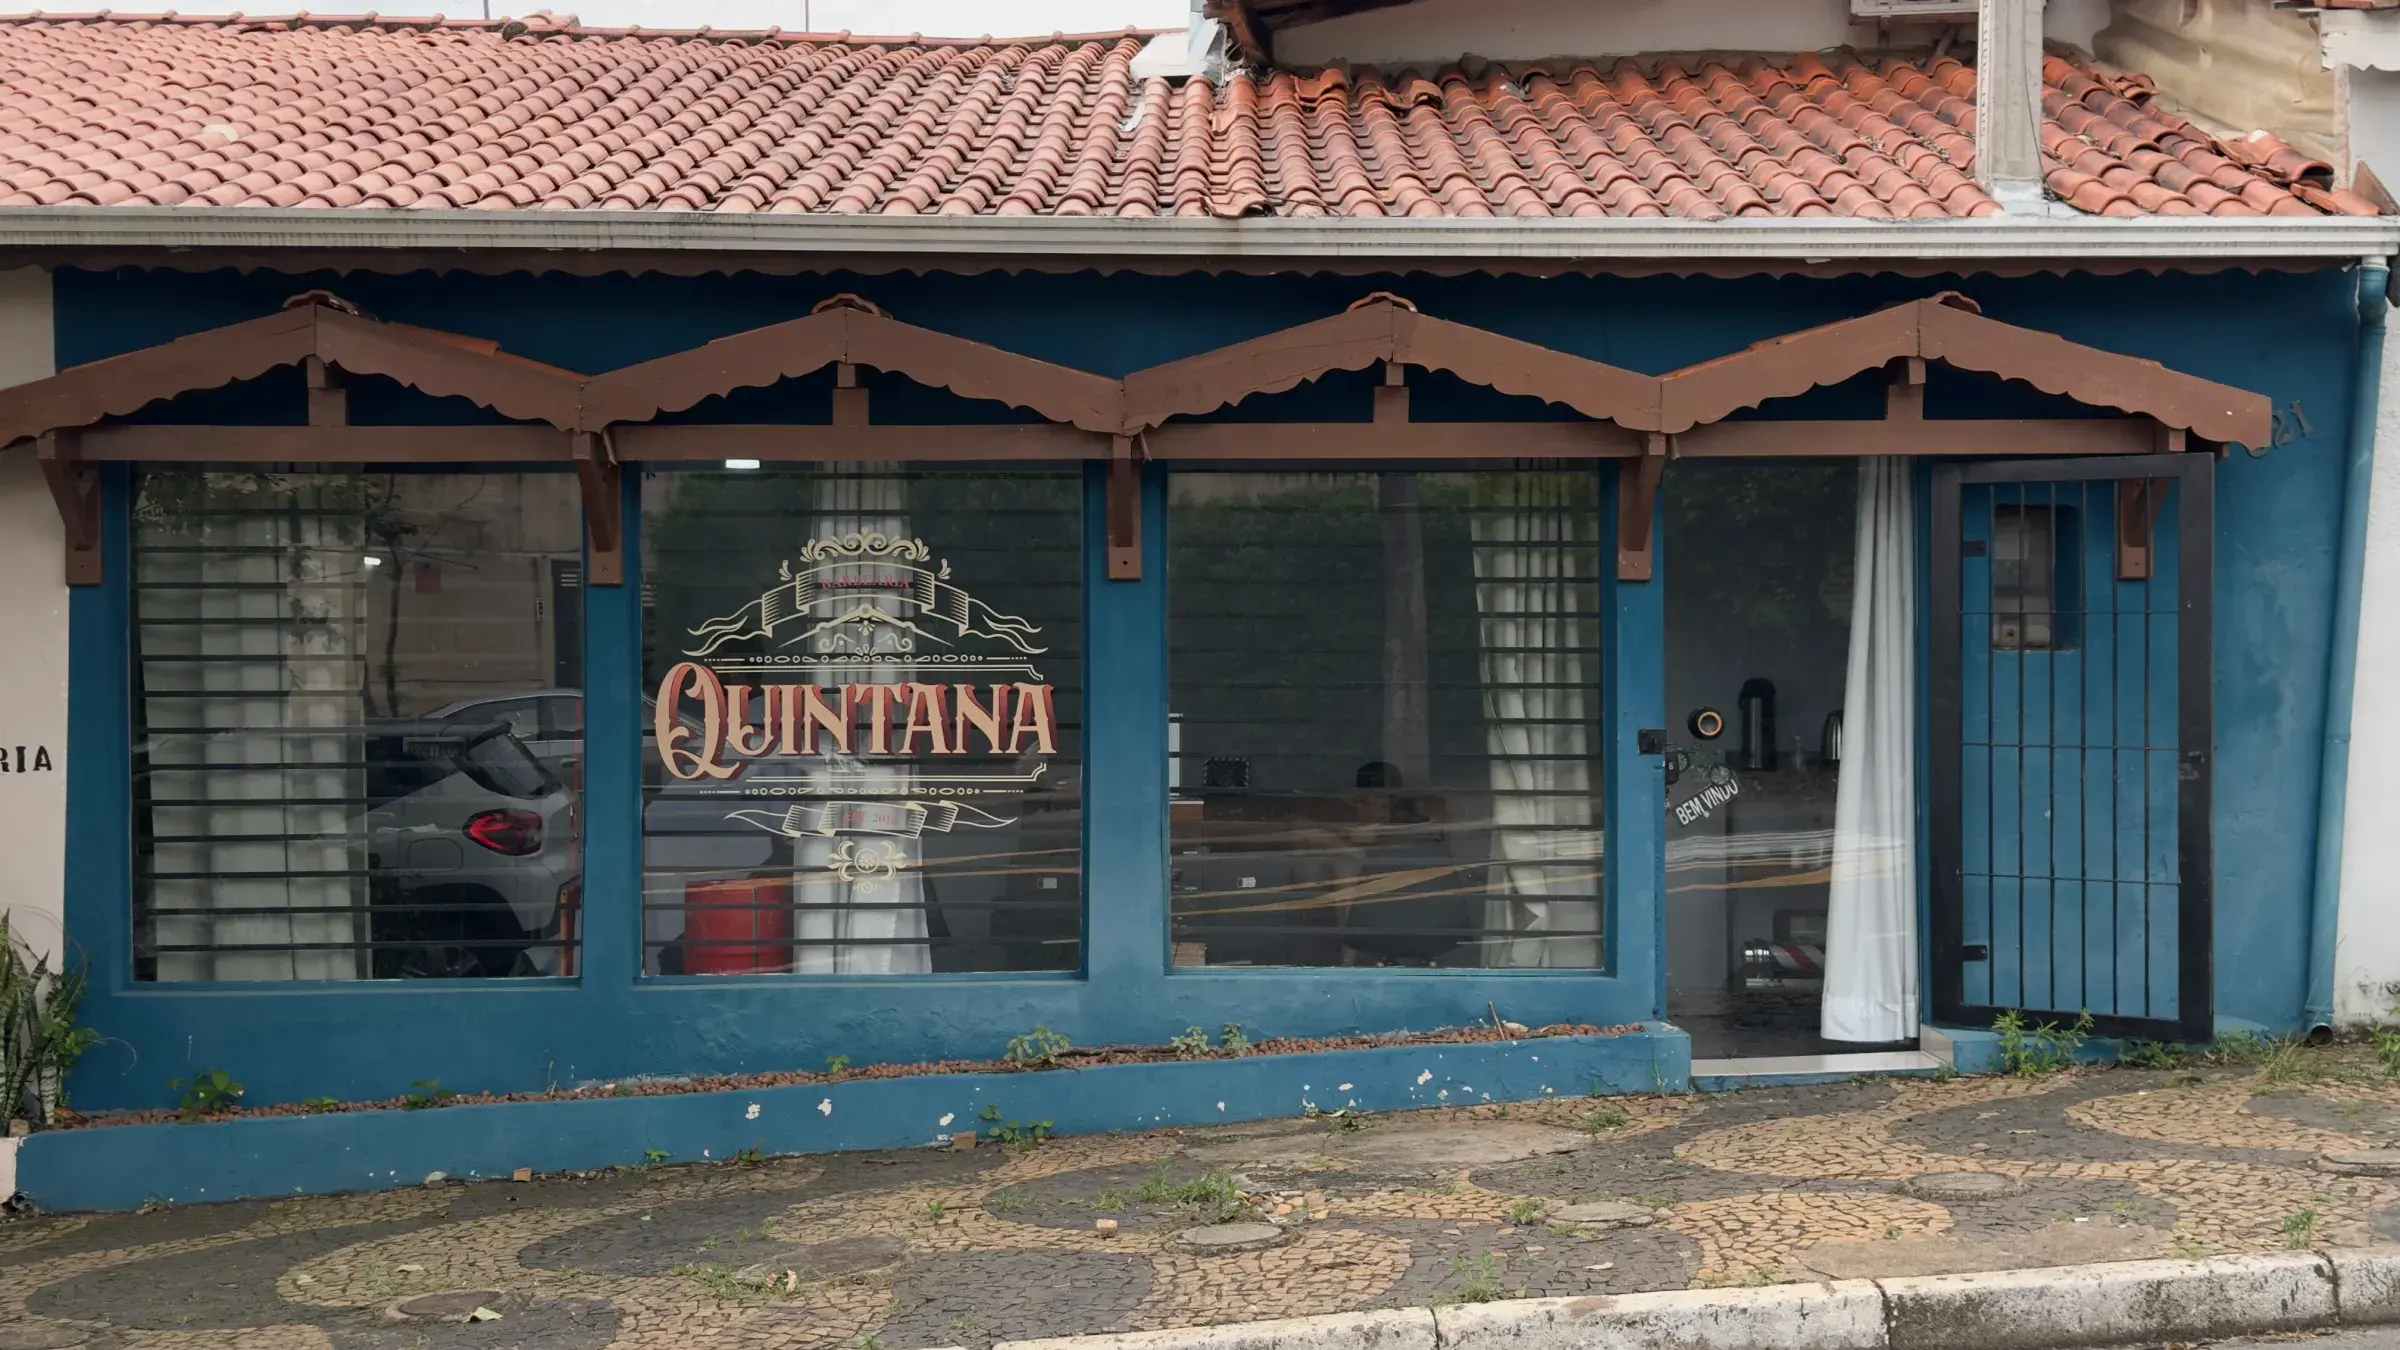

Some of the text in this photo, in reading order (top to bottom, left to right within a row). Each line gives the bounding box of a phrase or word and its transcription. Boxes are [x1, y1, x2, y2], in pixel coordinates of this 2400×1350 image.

[654, 661, 1059, 781] QUINTANA
[1675, 779, 1738, 825] BEM VINDO
